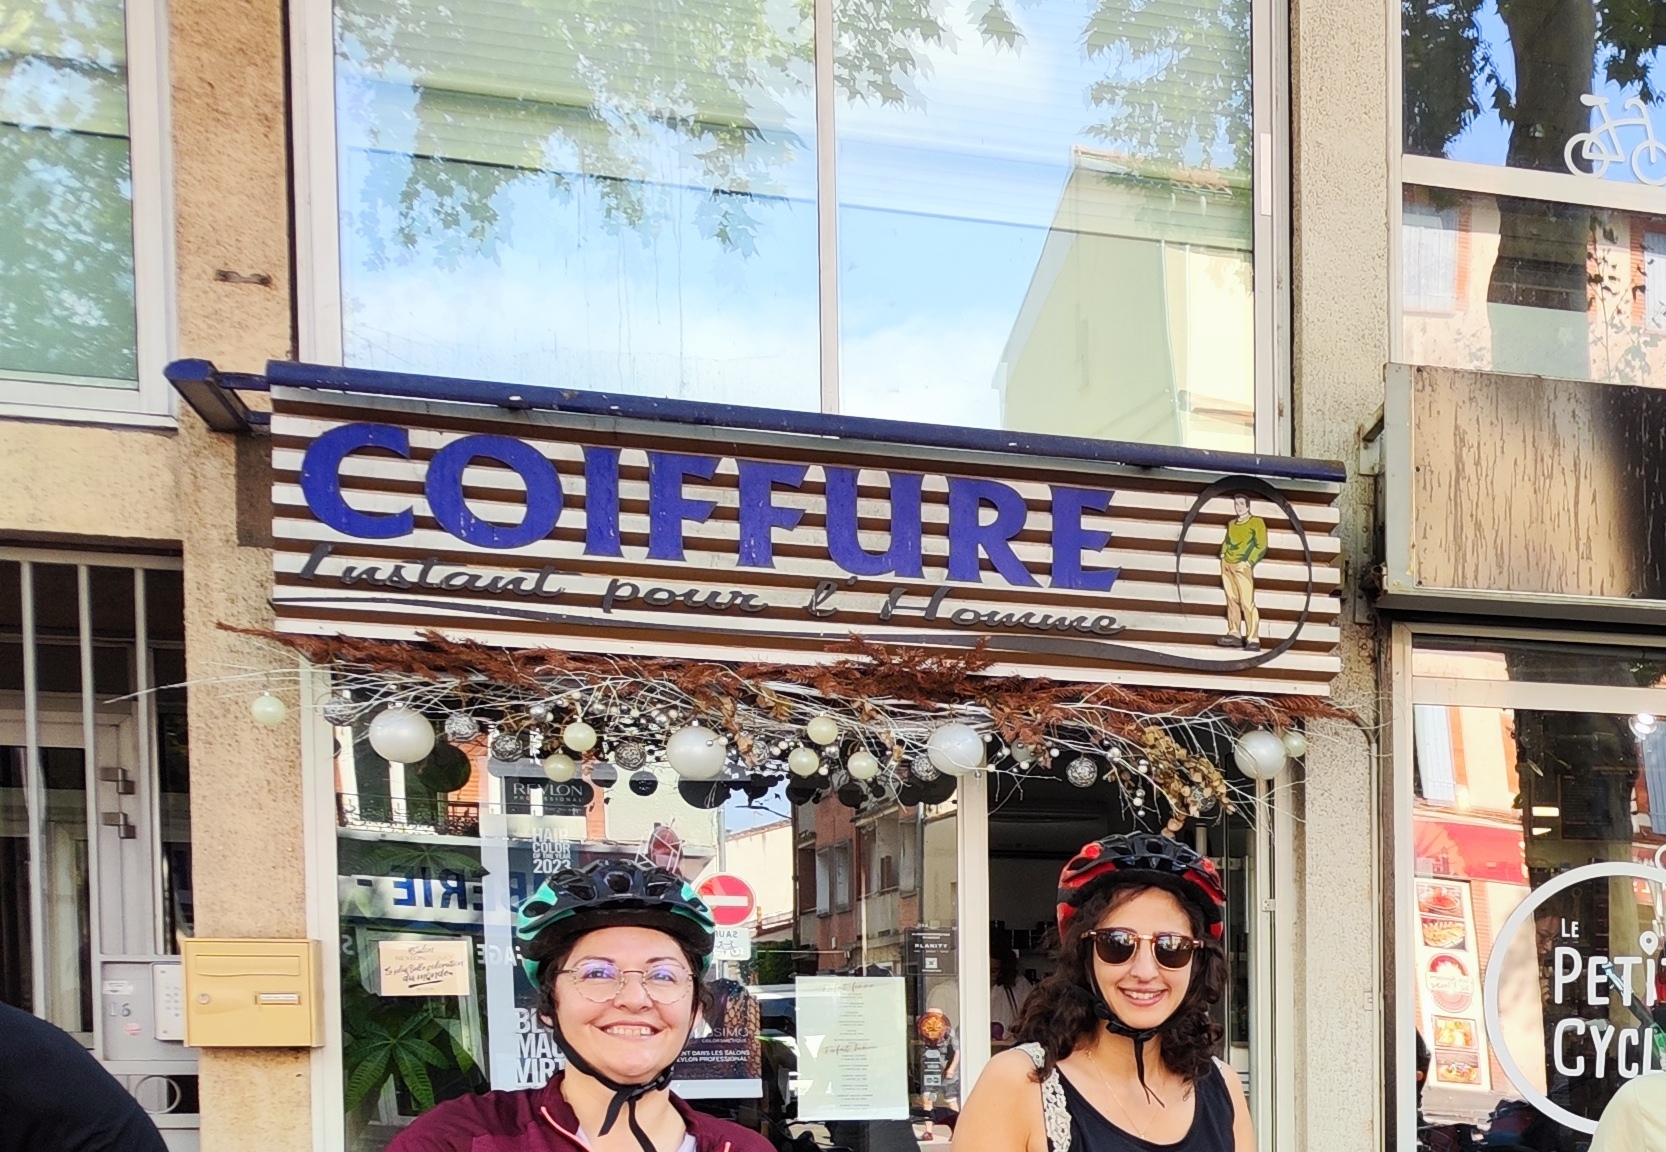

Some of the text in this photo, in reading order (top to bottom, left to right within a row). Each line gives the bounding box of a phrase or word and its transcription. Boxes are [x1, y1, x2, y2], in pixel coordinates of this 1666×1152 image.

[300, 423, 1121, 592] COIFFURE
[301, 543, 567, 600] Instant
[604, 577, 768, 614] pour
[532, 827, 569, 843] HAIR
[532, 842, 571, 853] COLOR
[532, 858, 571, 874] 2023
[1562, 919, 1580, 938] LE
